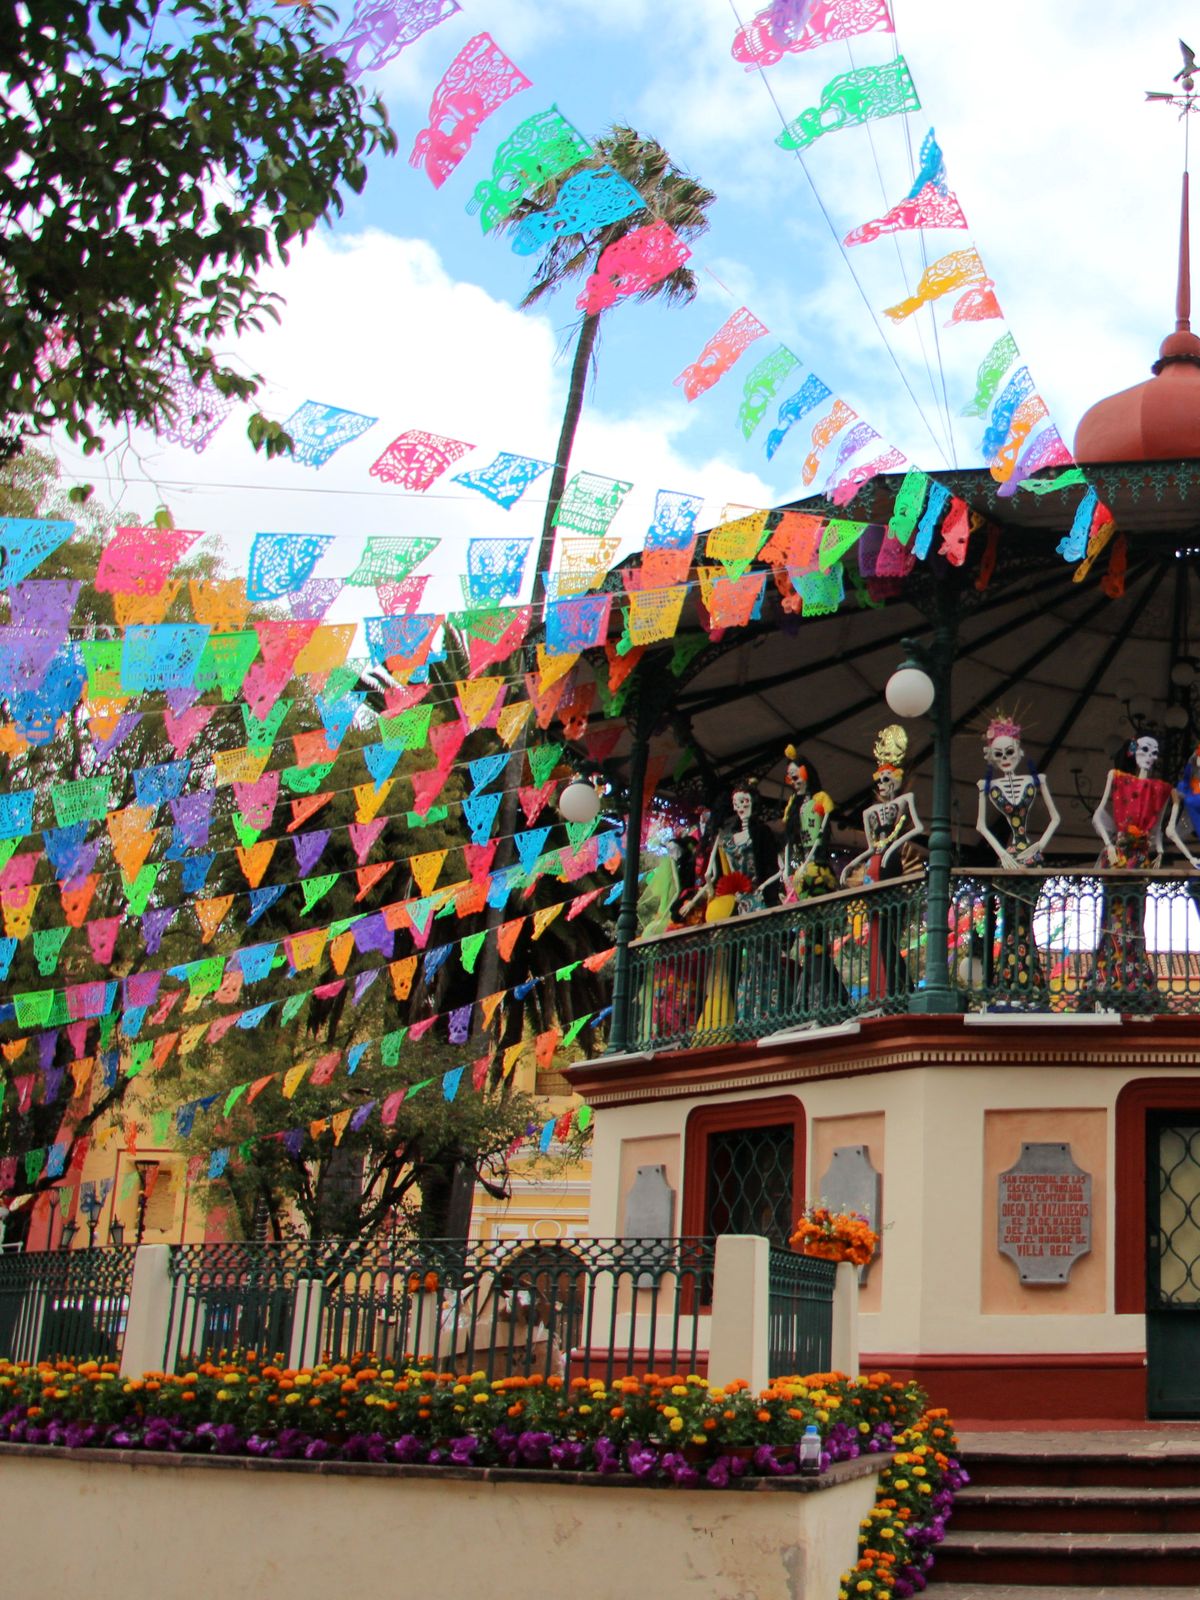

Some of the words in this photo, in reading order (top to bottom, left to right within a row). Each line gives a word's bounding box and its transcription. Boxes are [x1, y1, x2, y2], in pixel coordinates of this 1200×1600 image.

[1002, 1175, 1017, 1184] SAN
[1060, 1175, 1069, 1184] DE
[1072, 1175, 1085, 1184] LAS
[1002, 1203, 1026, 1217] DIEGO
[1029, 1203, 1039, 1217] DE
[1053, 1217, 1081, 1226] MARZO
[1017, 1244, 1044, 1257] VILLA
